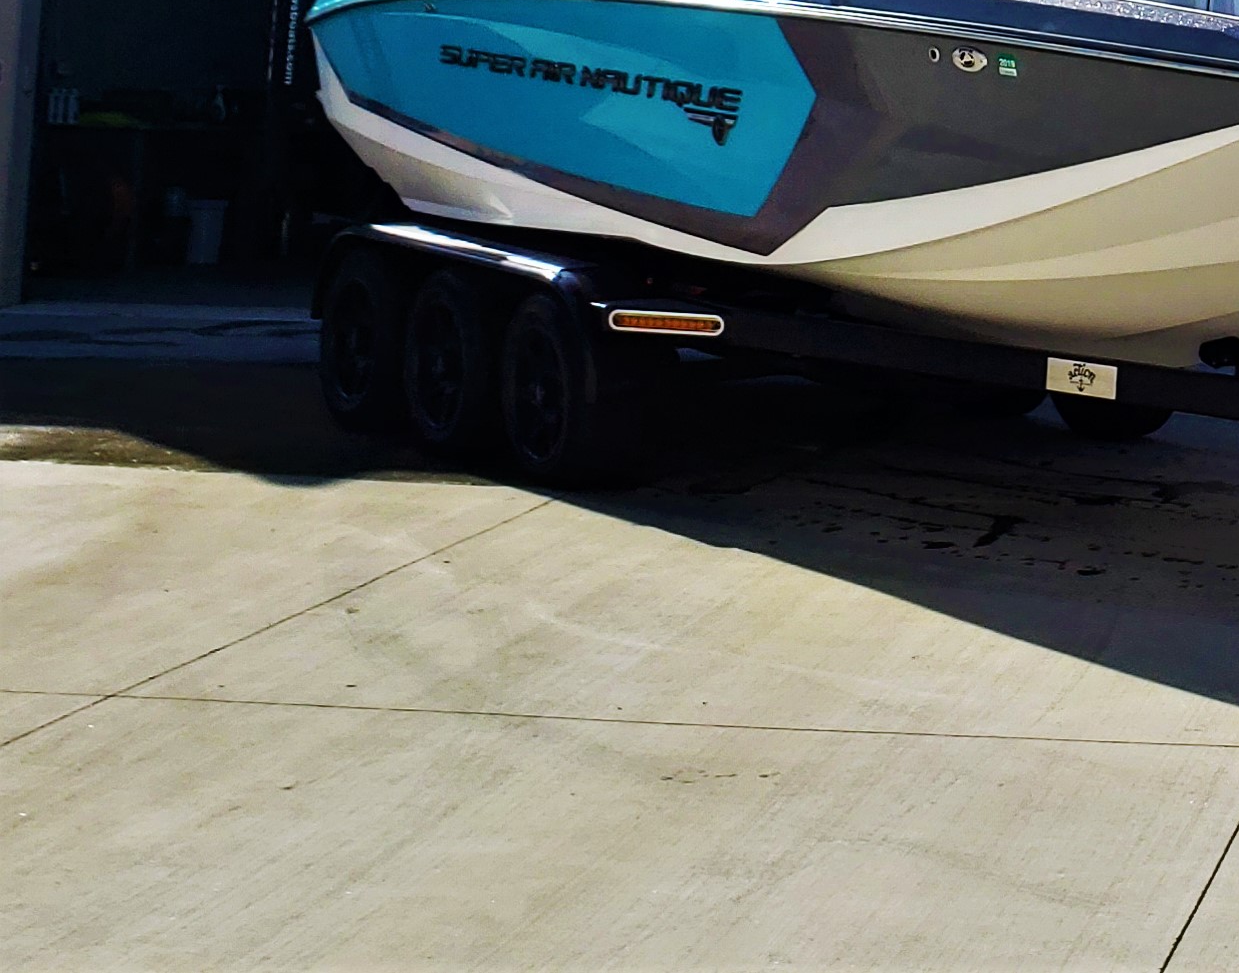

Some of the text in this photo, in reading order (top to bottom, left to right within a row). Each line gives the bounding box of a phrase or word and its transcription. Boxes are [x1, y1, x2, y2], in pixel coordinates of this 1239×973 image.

[439, 44, 743, 113] SUPER AIR NAUTIQUE
